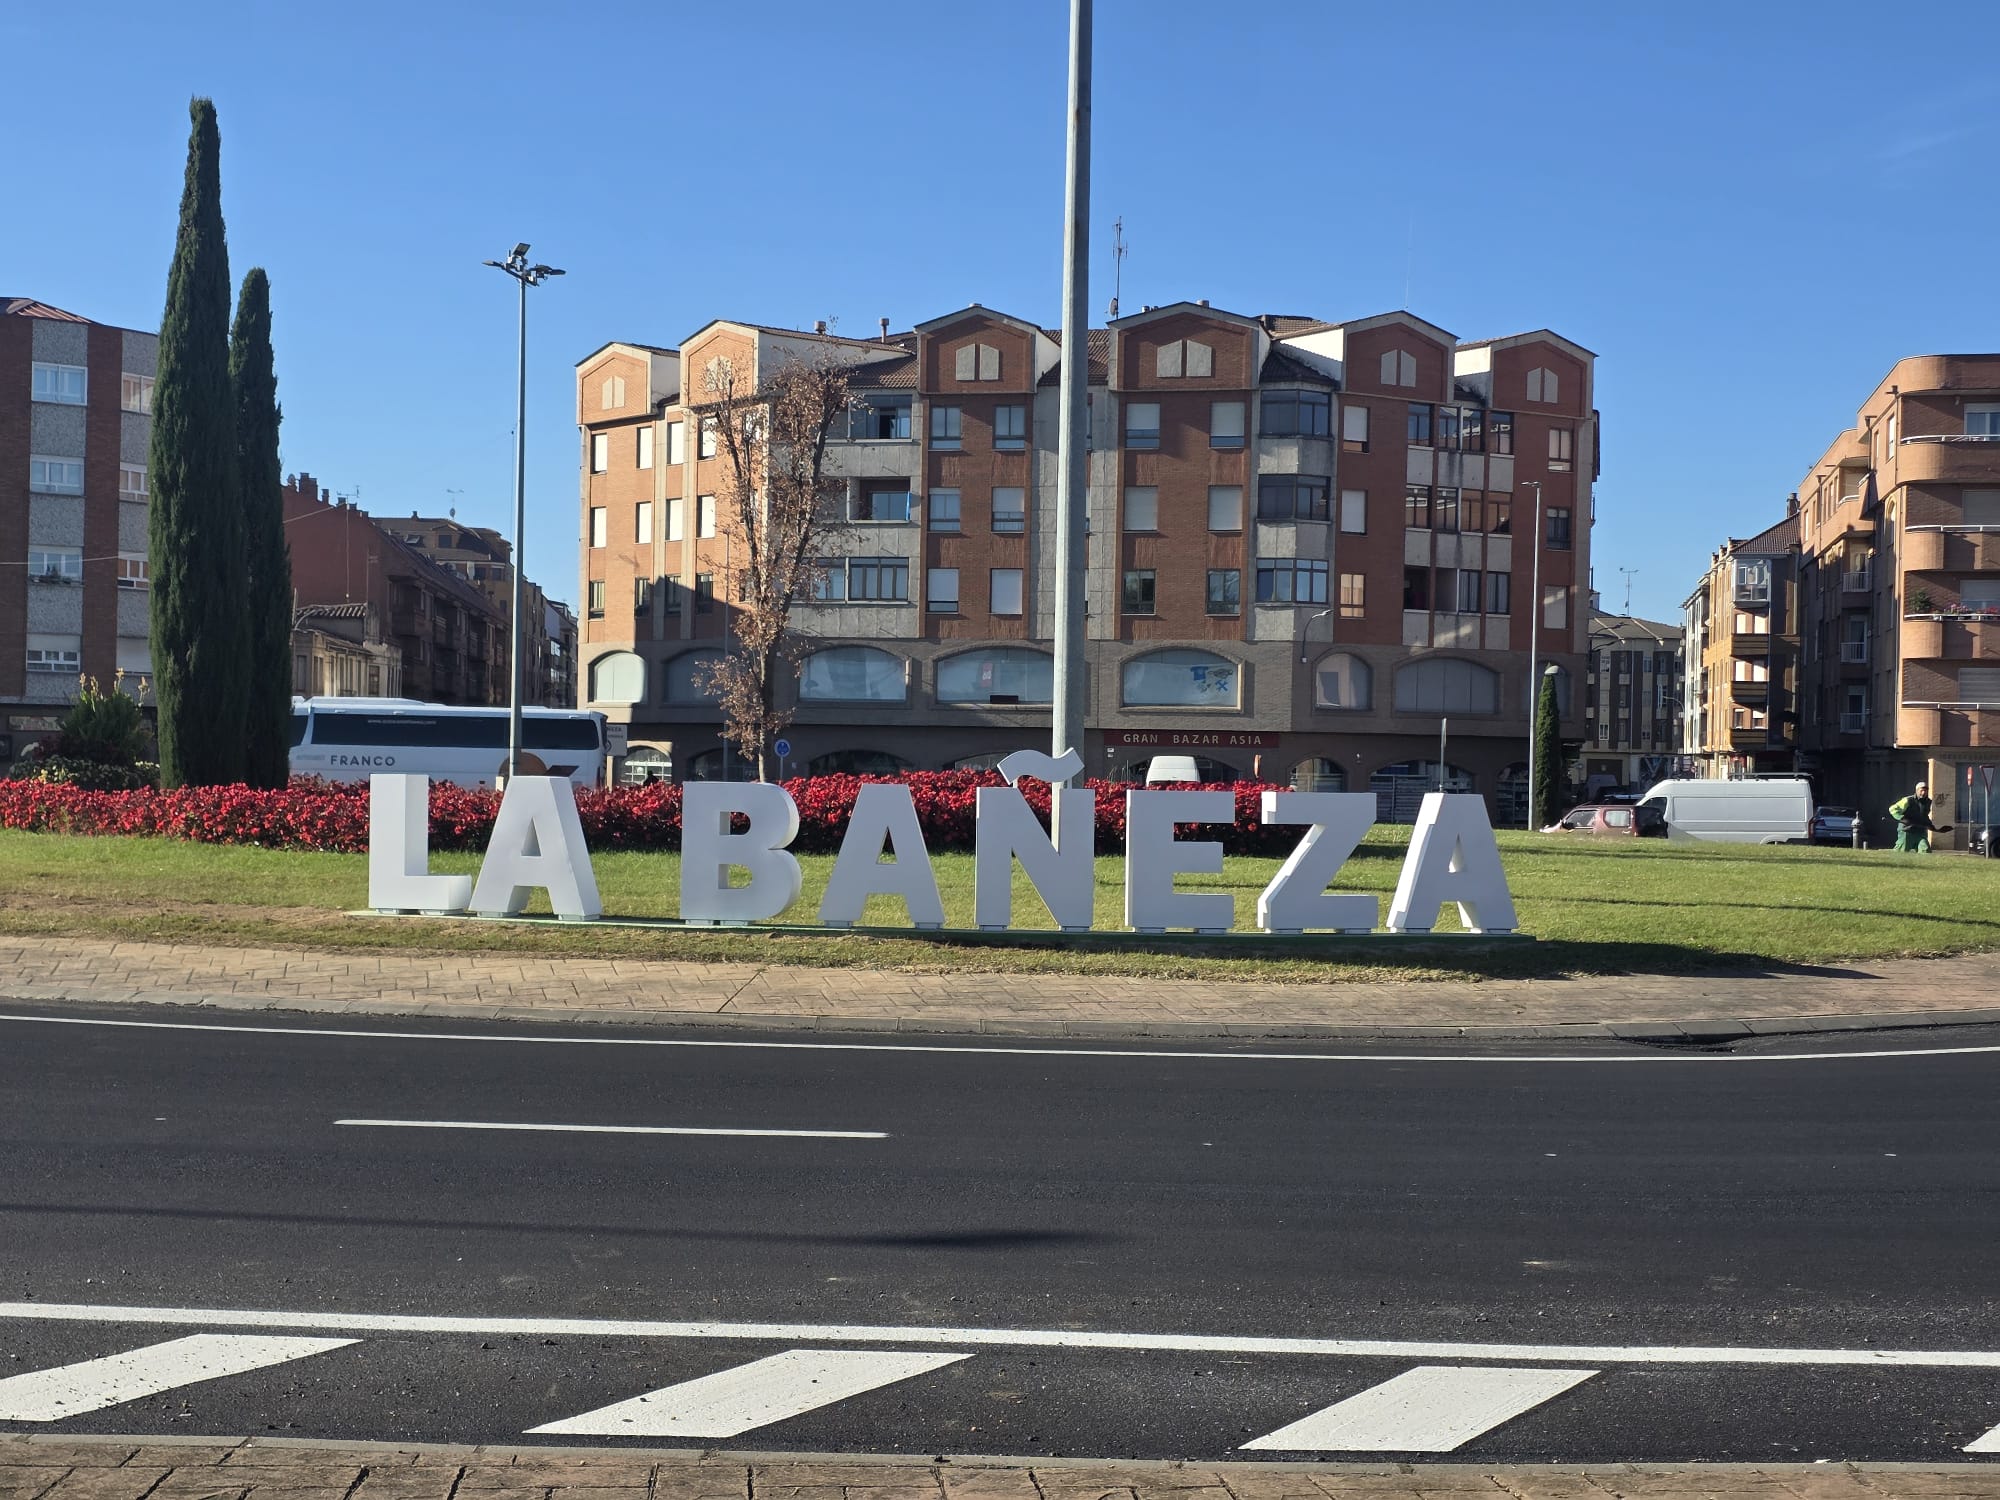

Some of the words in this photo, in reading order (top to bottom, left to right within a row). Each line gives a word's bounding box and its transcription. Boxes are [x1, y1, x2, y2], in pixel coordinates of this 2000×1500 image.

[1123, 733, 1158, 743] GRAN
[1173, 734, 1219, 744] BAZAR
[1229, 735, 1262, 745] ASIA
[330, 754, 396, 767] FRANCO
[368, 773, 600, 919] LA
[680, 747, 1519, 930] BAÑEZA
